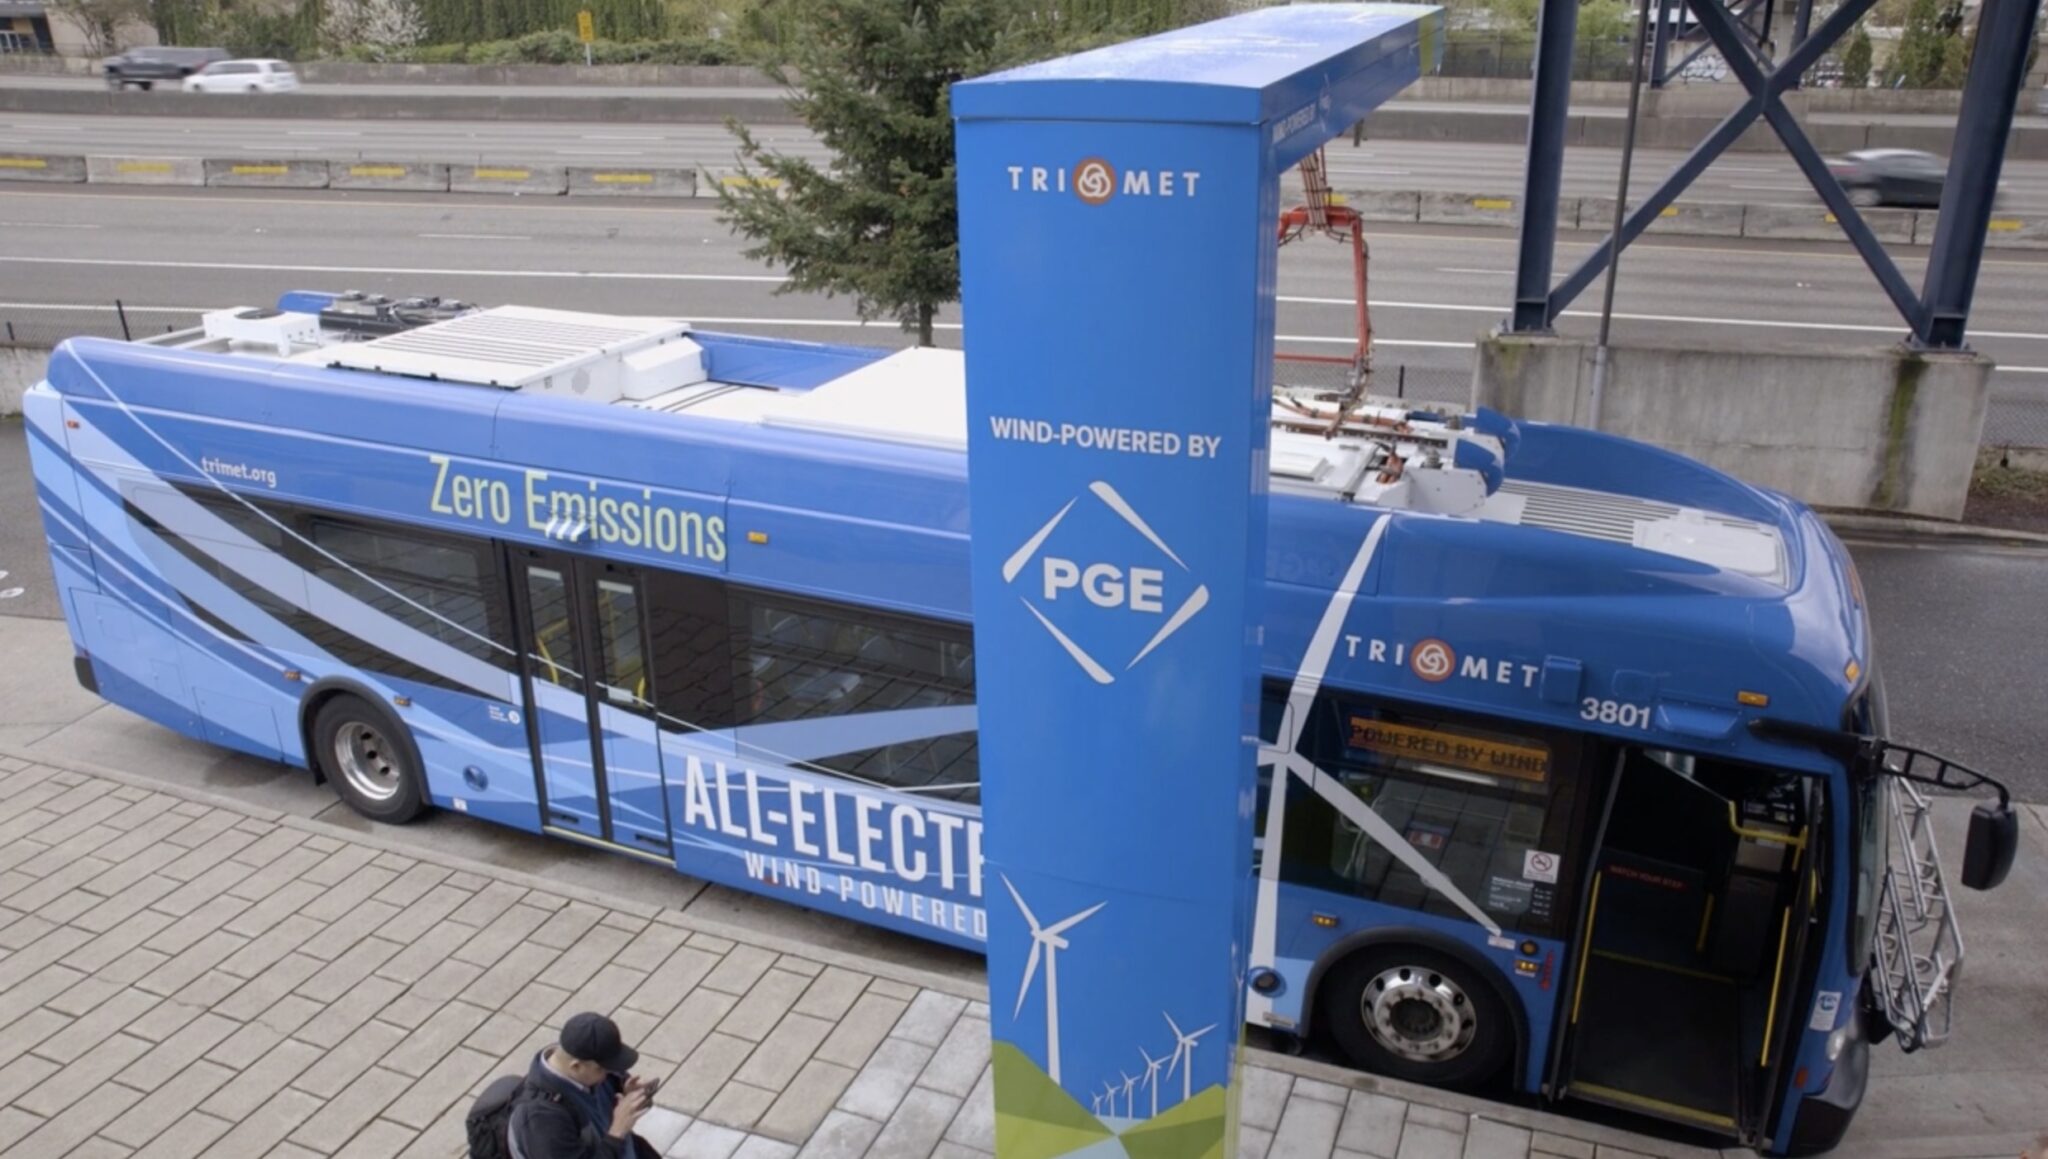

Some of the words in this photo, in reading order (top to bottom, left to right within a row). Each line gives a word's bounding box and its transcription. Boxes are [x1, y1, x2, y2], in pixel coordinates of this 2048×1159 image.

[1007, 166, 1065, 192] TRI
[1123, 170, 1200, 197] MET
[990, 416, 1181, 455] WIND-POWERED
[1188, 435, 1221, 458] BY
[202, 457, 277, 488] trimet.org
[429, 454, 511, 524] Zero
[525, 469, 727, 563] Emissions
[1043, 556, 1164, 613] PGE
[1345, 635, 1403, 666] TRI
[1460, 655, 1539, 688] MET
[1580, 697, 1650, 730] 3801
[1350, 724, 1448, 755] POWERED
[1455, 743, 1484, 763] BY
[1490, 751, 1546, 774] WIND
[745, 850, 987, 938] WIND-POWERED
